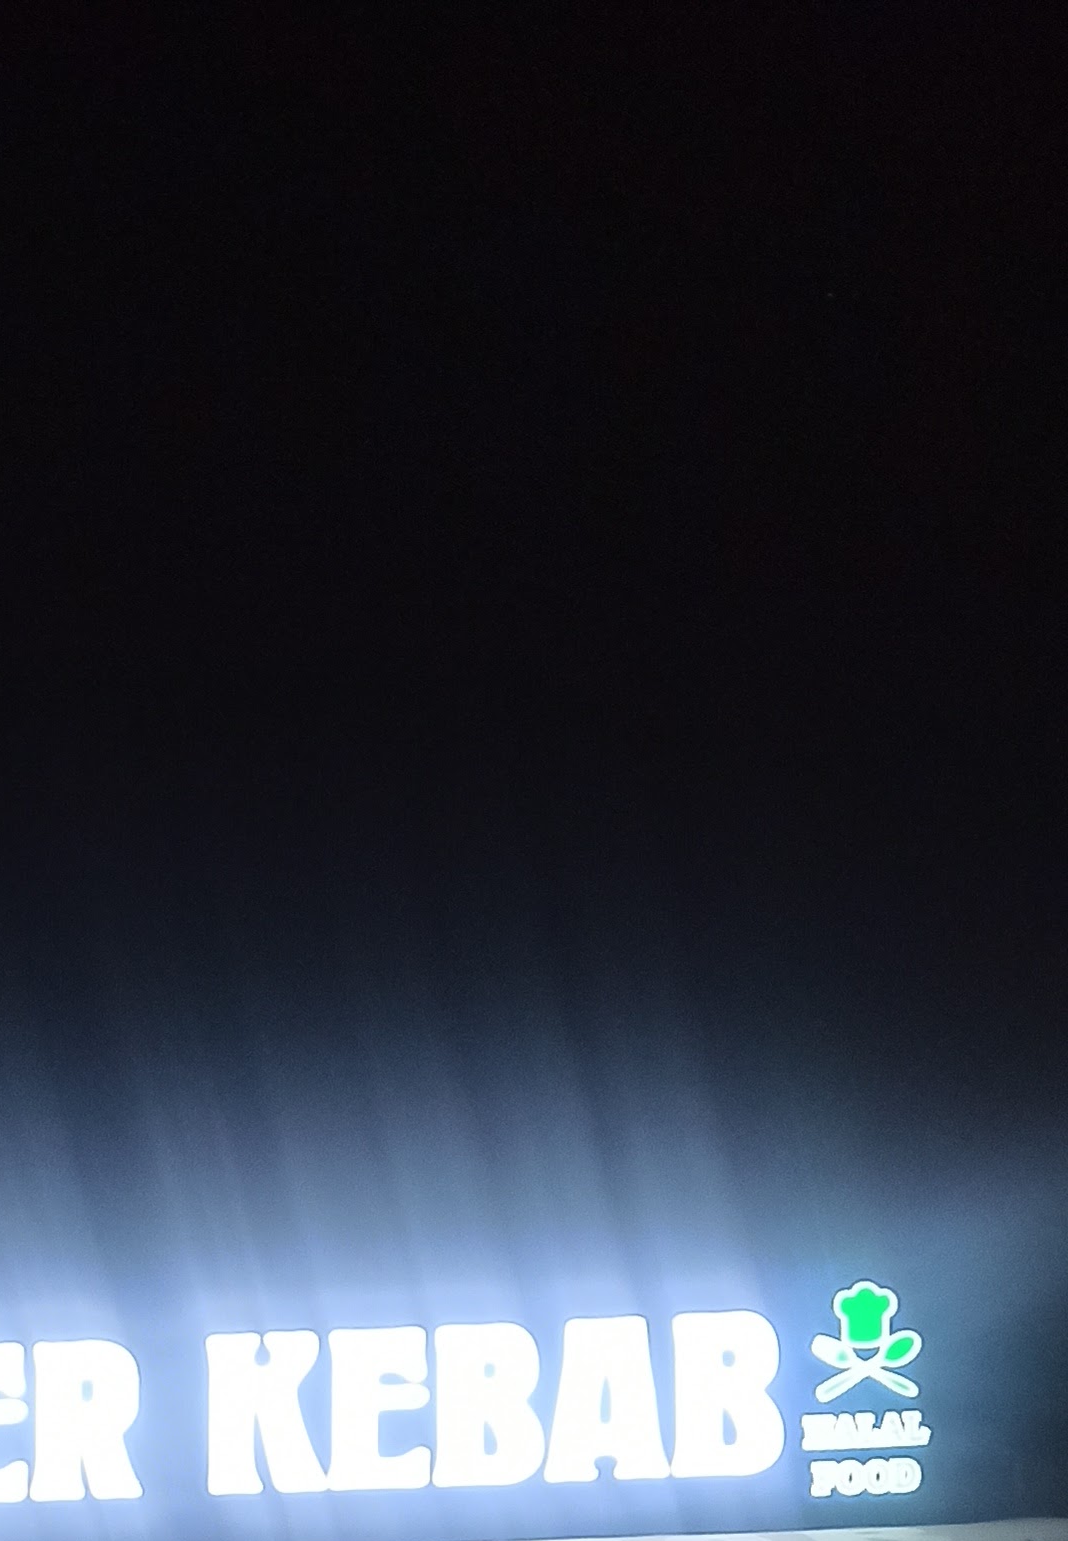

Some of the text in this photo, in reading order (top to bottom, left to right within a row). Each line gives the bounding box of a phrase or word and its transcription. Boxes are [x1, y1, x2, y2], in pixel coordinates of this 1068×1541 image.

[206, 1309, 785, 1495] KEBAB
[801, 1411, 930, 1451] HALAL
[811, 1457, 921, 1496] FOOD
